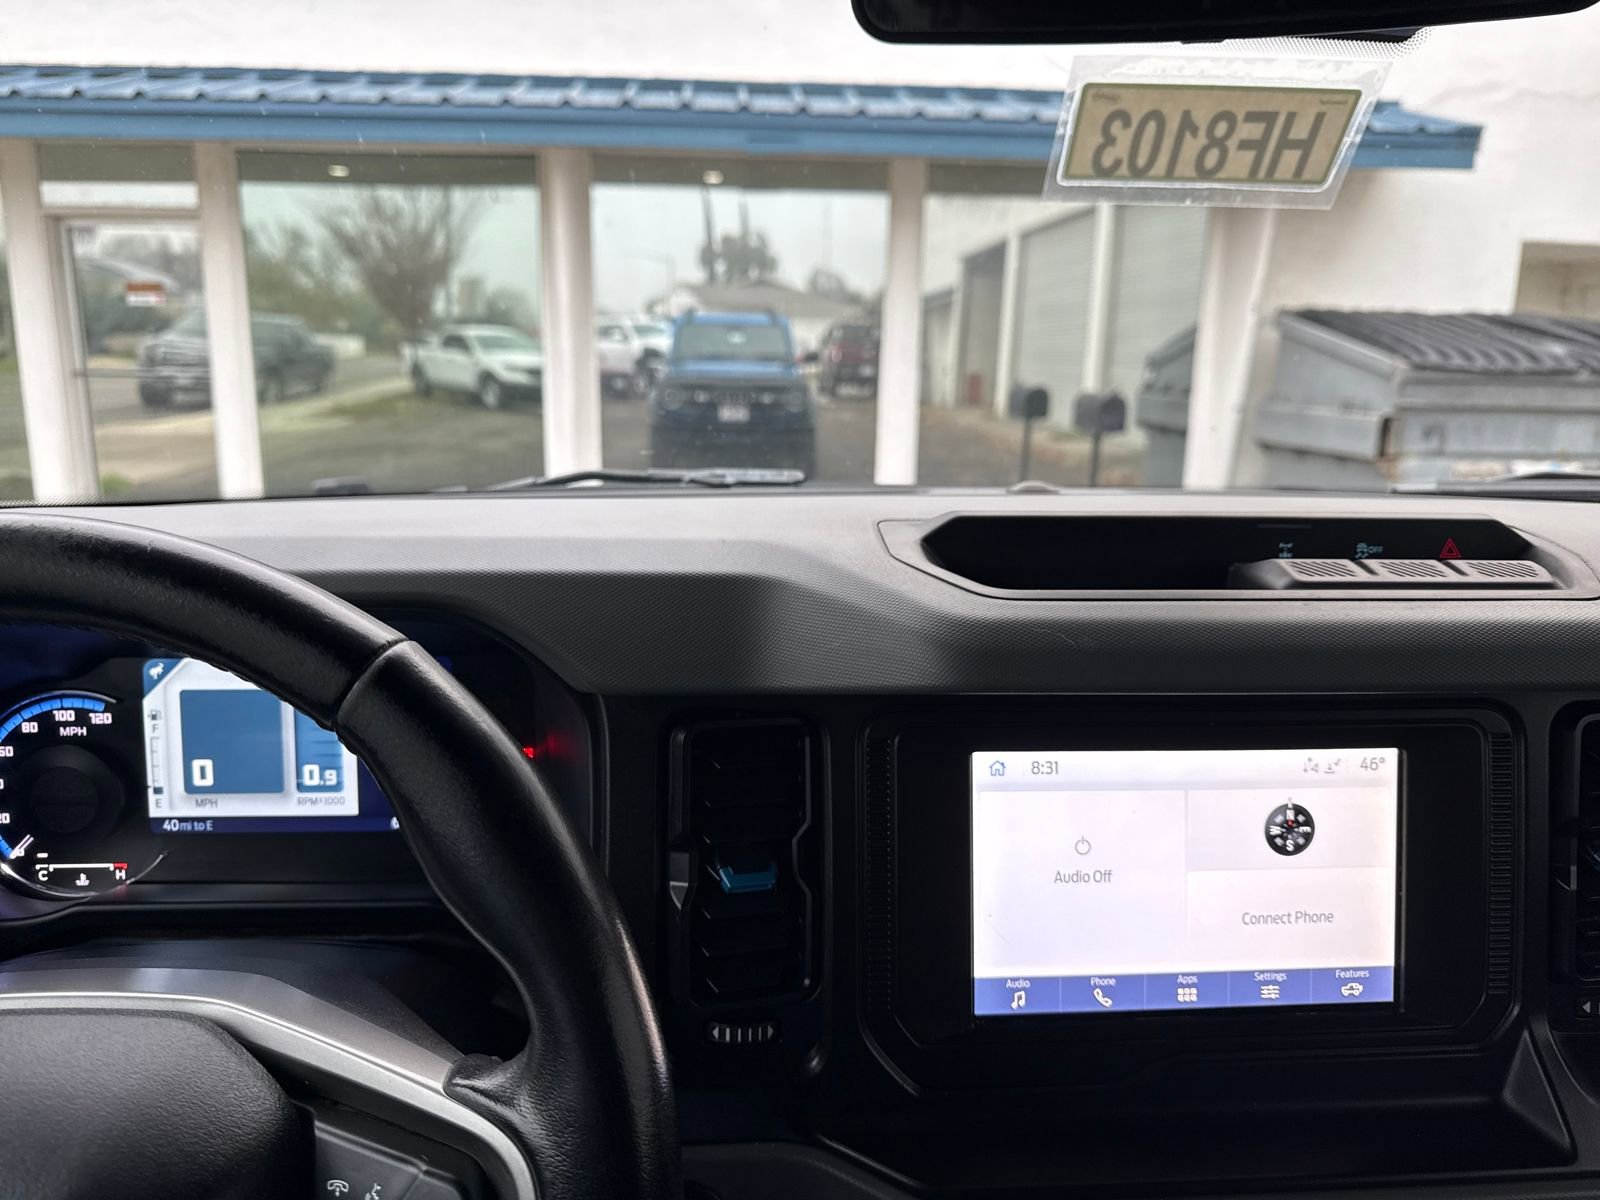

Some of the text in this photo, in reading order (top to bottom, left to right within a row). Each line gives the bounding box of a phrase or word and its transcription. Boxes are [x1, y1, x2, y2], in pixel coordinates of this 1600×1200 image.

[52, 710, 76, 721] 100
[88, 712, 112, 724] 120
[21, 722, 38, 733] 80
[59, 726, 87, 736] MPH
[151, 723, 159, 733] F
[192, 759, 214, 787] 0
[1031, 760, 1059, 775] 8:31
[303, 764, 337, 786] 0.9
[155, 799, 162, 808] E
[195, 799, 218, 808] MPH
[0, 812, 10, 824] 0
[193, 821, 205, 831] to
[206, 820, 213, 831] E
[1285, 839, 1295, 852] S
[38, 869, 48, 881] C
[115, 868, 126, 880] H
[1054, 869, 1112, 884] Audio Off
[1241, 909, 1334, 926] Connect Phone
[1253, 971, 1287, 982] Settings
[1335, 968, 1370, 978] Features
[1006, 979, 1031, 988] Audio
[1090, 976, 1116, 986] Phone
[1176, 974, 1198, 985] Apps
